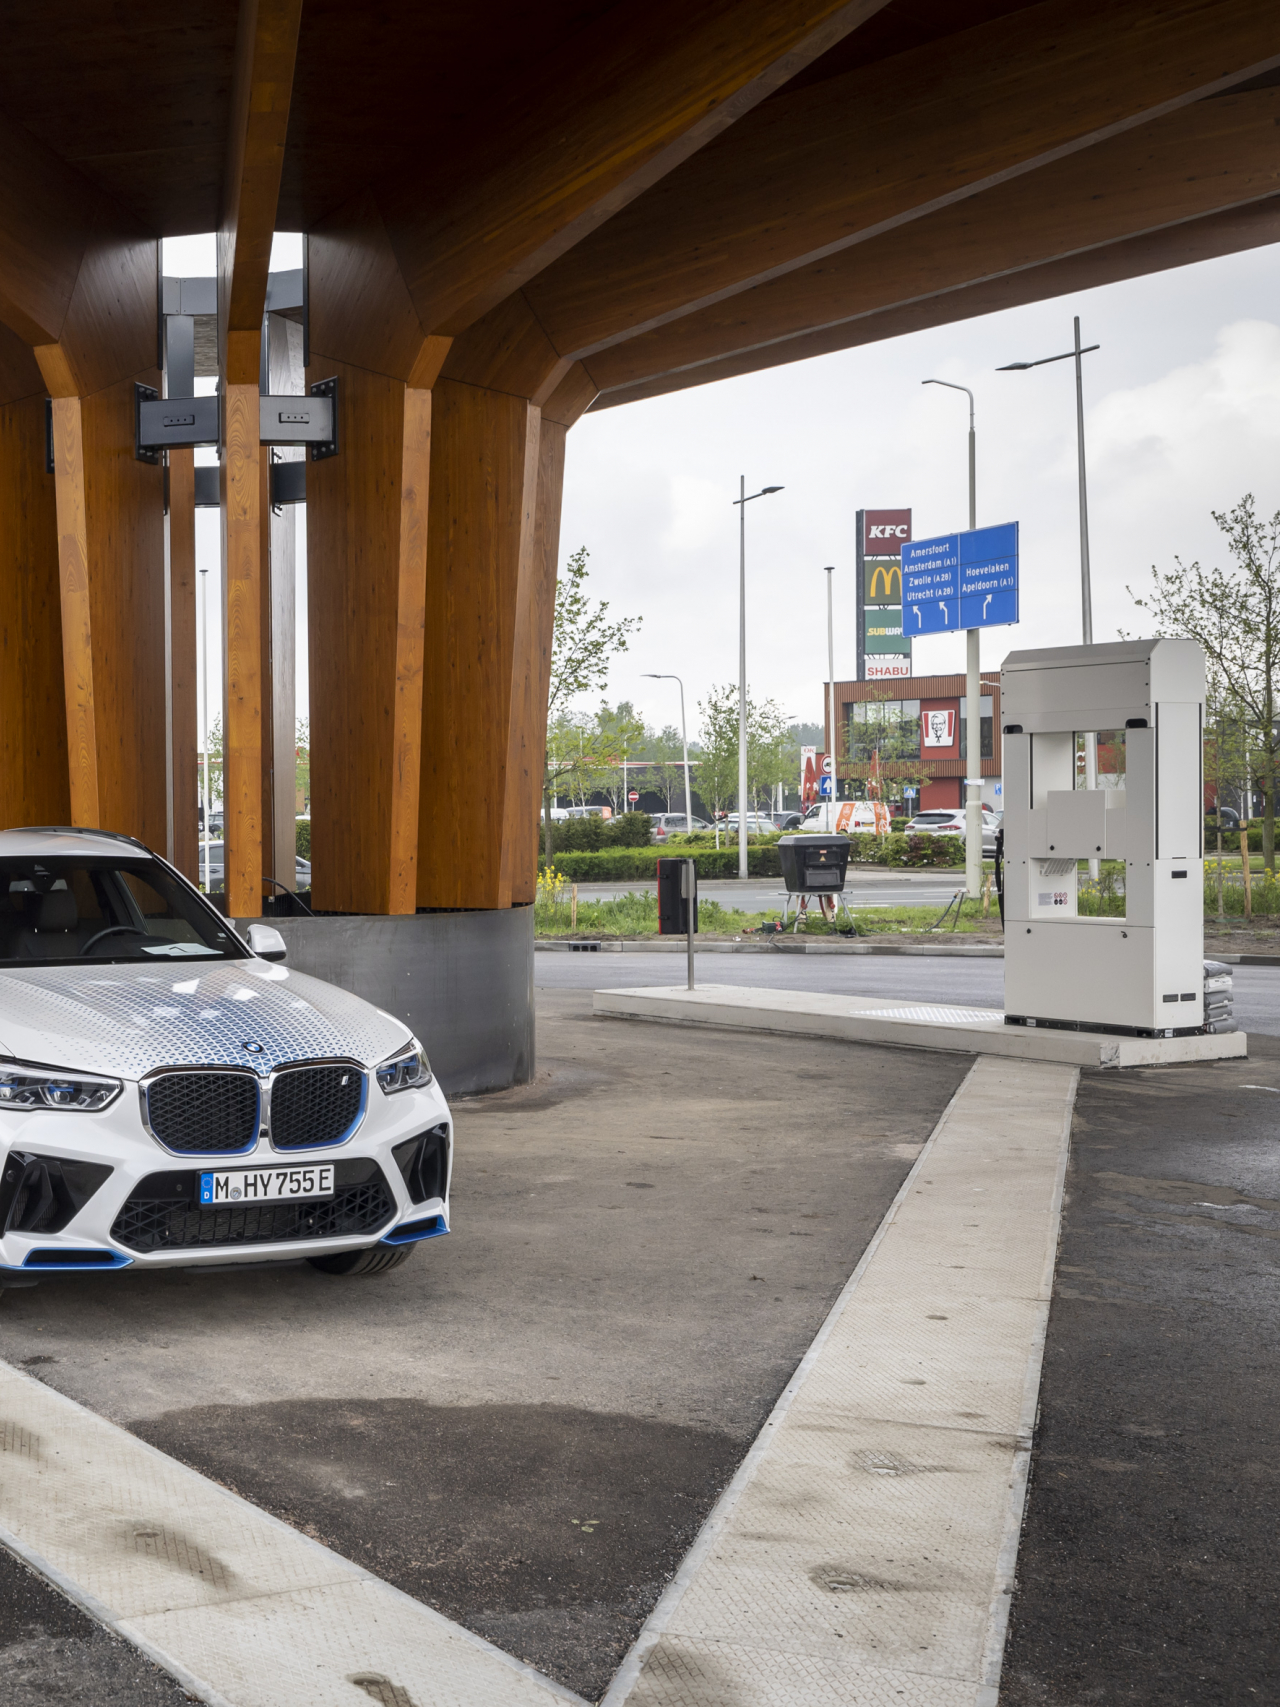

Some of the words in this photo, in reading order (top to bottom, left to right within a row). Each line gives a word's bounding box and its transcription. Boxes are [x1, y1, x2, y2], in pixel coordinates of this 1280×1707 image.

[869, 525, 907, 538] KFC
[910, 543, 950, 558] Amersfoort
[904, 560, 942, 573] Amsterdam
[966, 563, 1009, 577] Hoevelaken
[909, 575, 932, 587] Zwolle
[933, 572, 951, 583] (A28)
[962, 580, 998, 593] Apeldoorn
[907, 589, 934, 601] Utrecht
[935, 586, 954, 597] (A28)
[867, 667, 909, 676] SHABU
[204, 1191, 210, 1200] D
